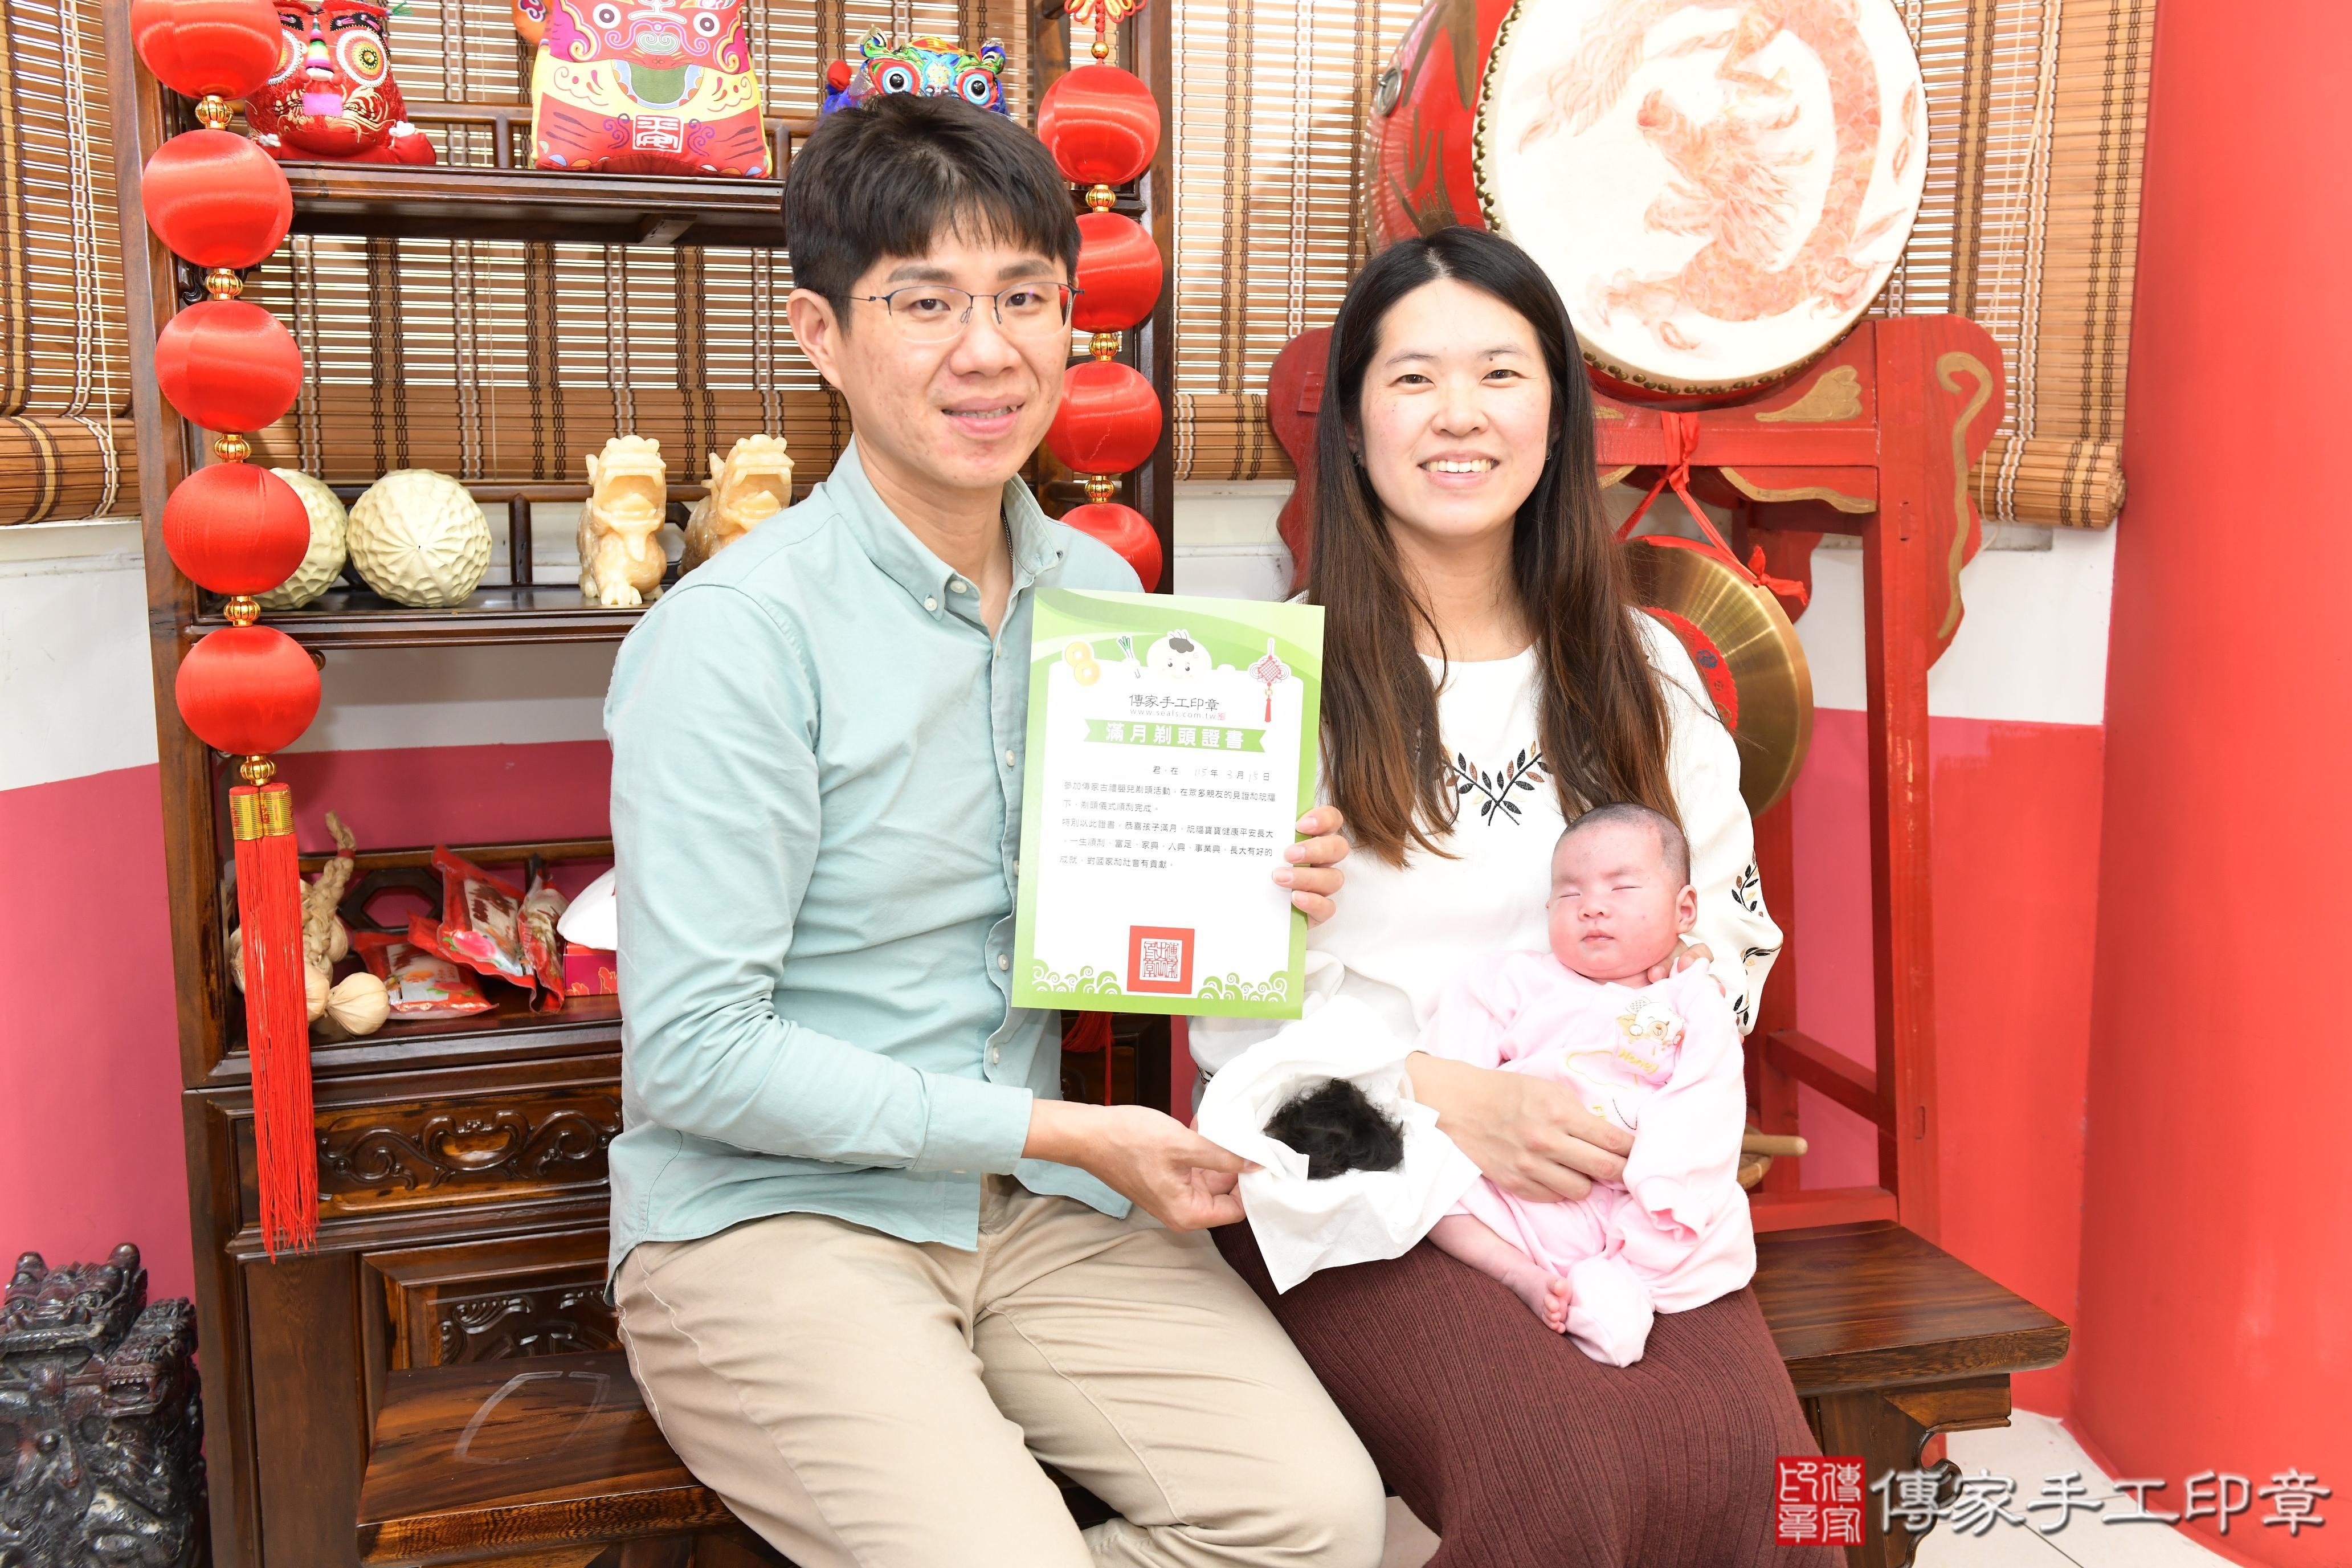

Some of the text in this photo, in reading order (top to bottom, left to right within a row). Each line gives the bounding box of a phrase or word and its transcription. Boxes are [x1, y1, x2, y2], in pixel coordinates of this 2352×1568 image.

[1129, 694, 1219, 712] 傳家手工印章
[1130, 708, 1216, 720] www.seals.com.tw
[1106, 721, 1244, 749] 滿月剃頭證書
